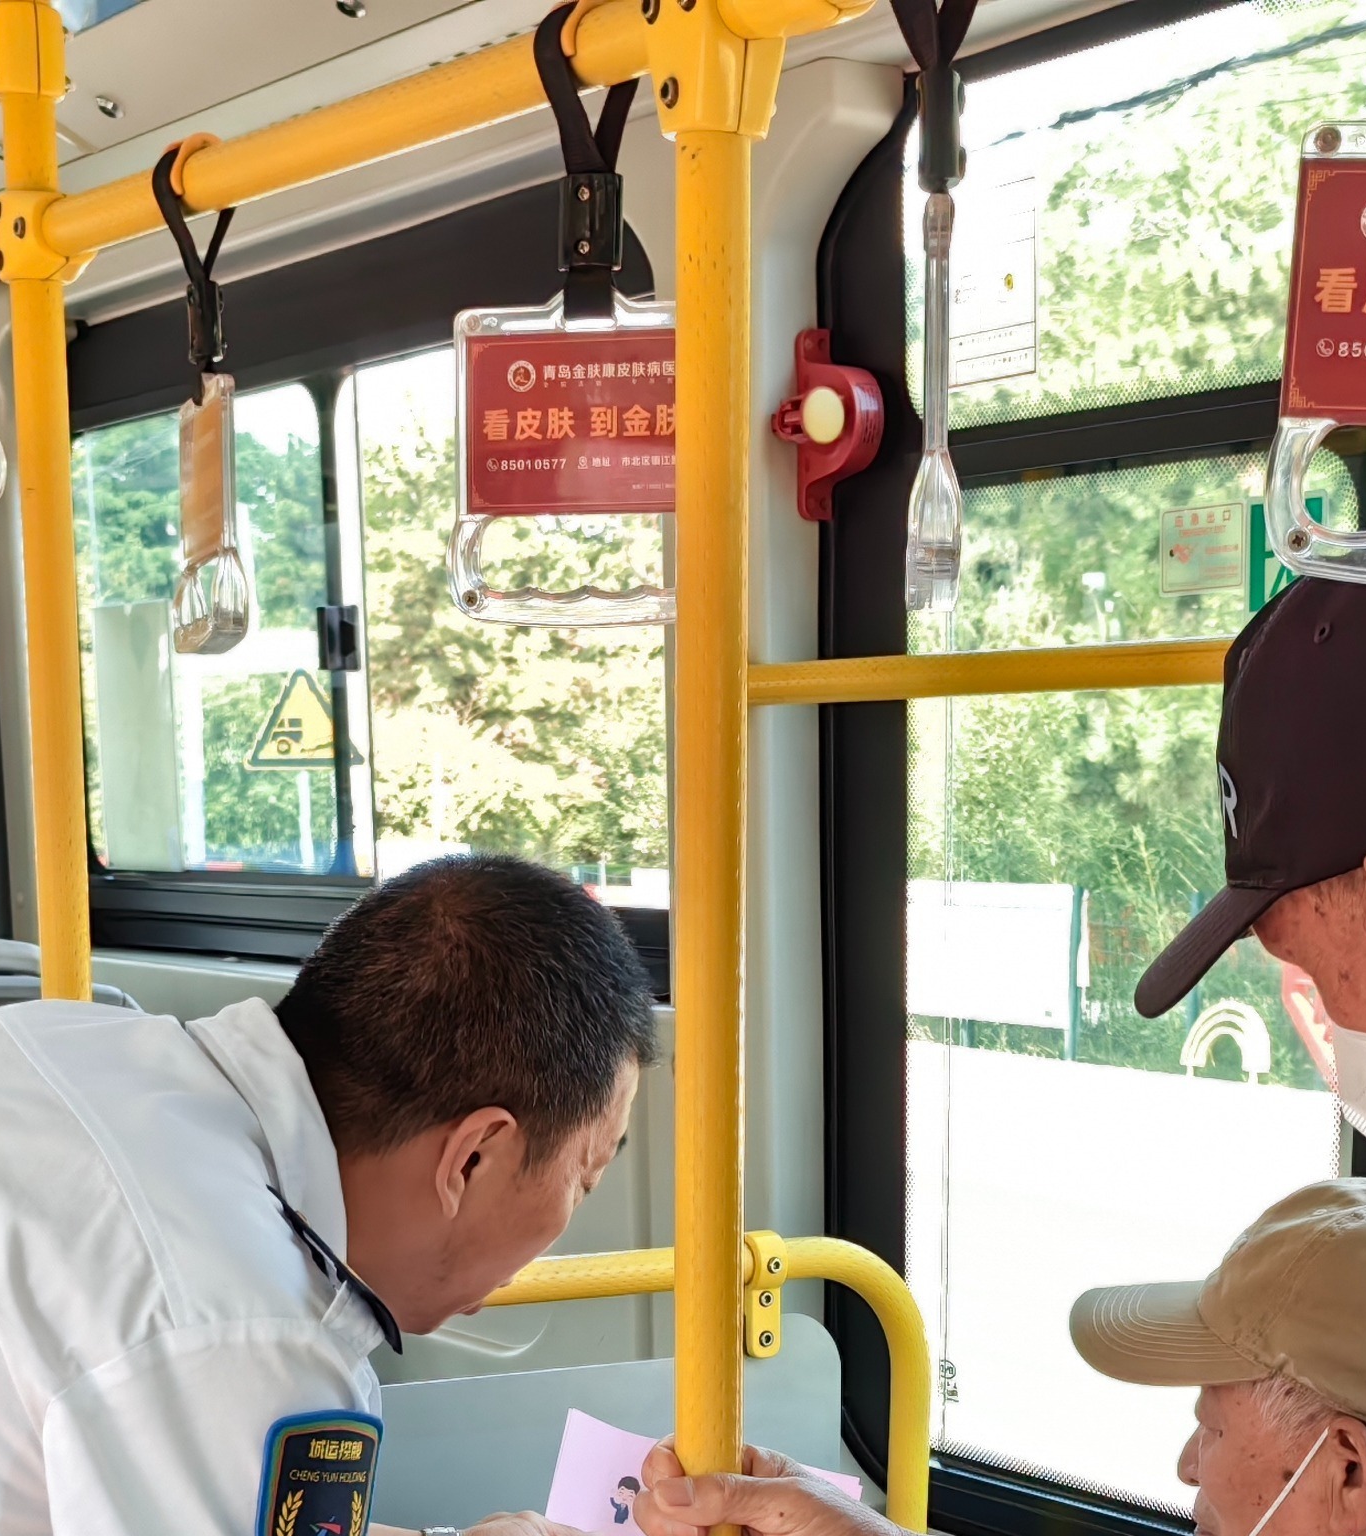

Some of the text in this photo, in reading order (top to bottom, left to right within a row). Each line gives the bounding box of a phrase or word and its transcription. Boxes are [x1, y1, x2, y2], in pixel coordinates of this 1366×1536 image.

[483, 406, 576, 442] 看皮肤
[500, 458, 567, 471] 85010577
[621, 455, 675, 467] 市北区镇江
[308, 1438, 363, 1460] 城运控股
[289, 1470, 320, 1482] CHENG
[321, 1471, 339, 1483] YUN
